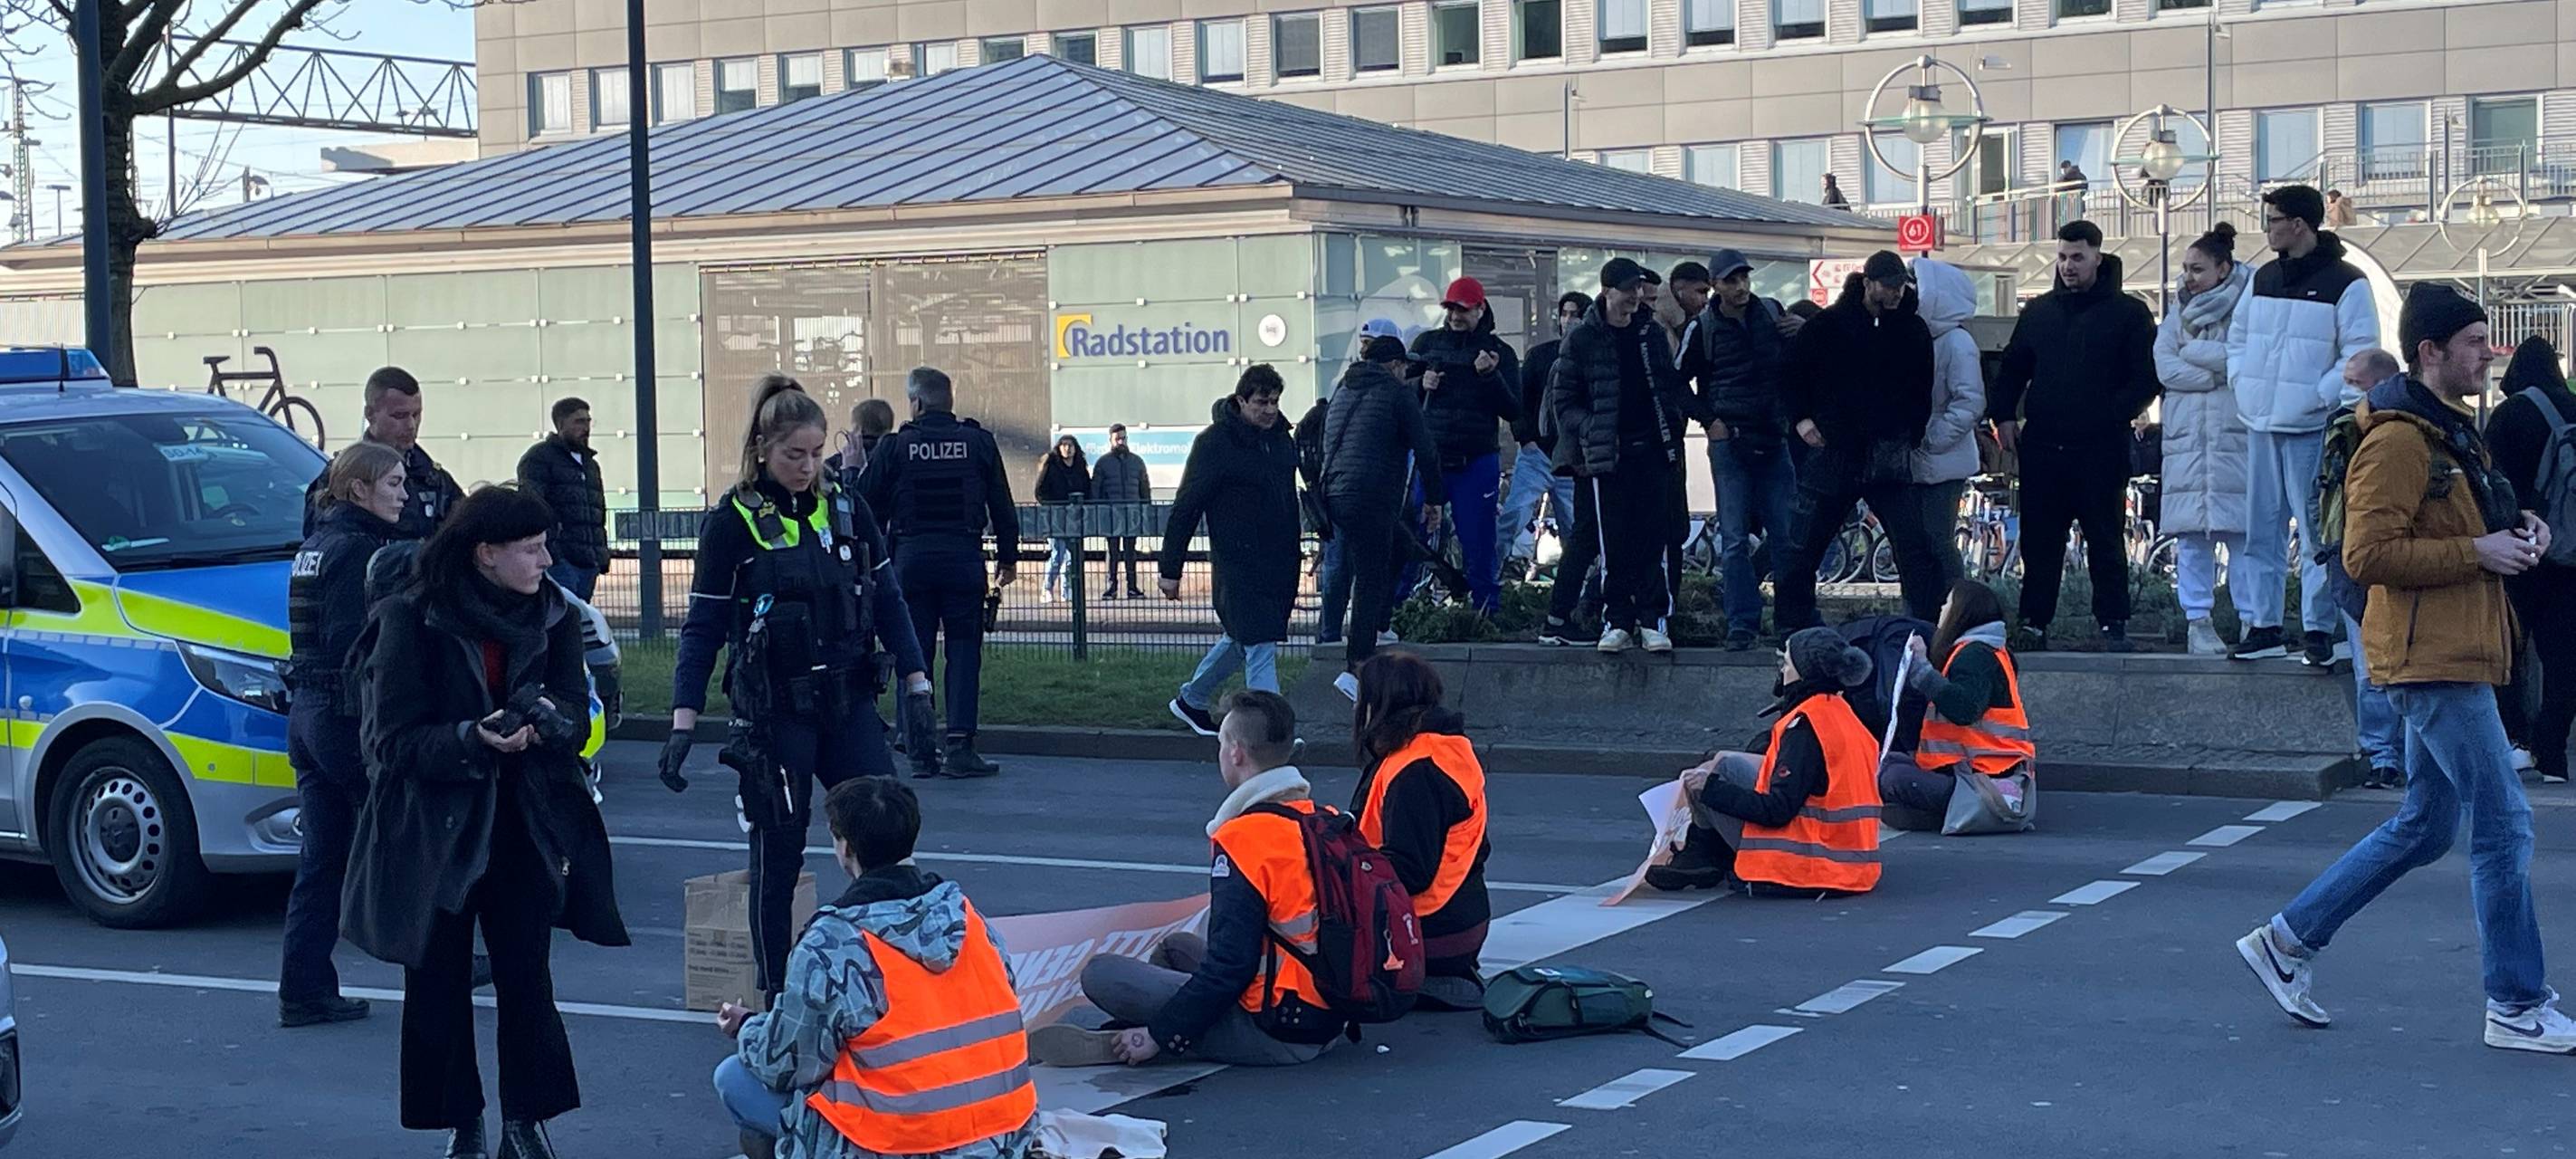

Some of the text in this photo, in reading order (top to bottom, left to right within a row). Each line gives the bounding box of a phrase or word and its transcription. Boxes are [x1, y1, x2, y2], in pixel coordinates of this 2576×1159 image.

[1909, 224, 1922, 236] 61
[1072, 322, 1230, 357] Radstation
[909, 442, 968, 460] POLIZEI
